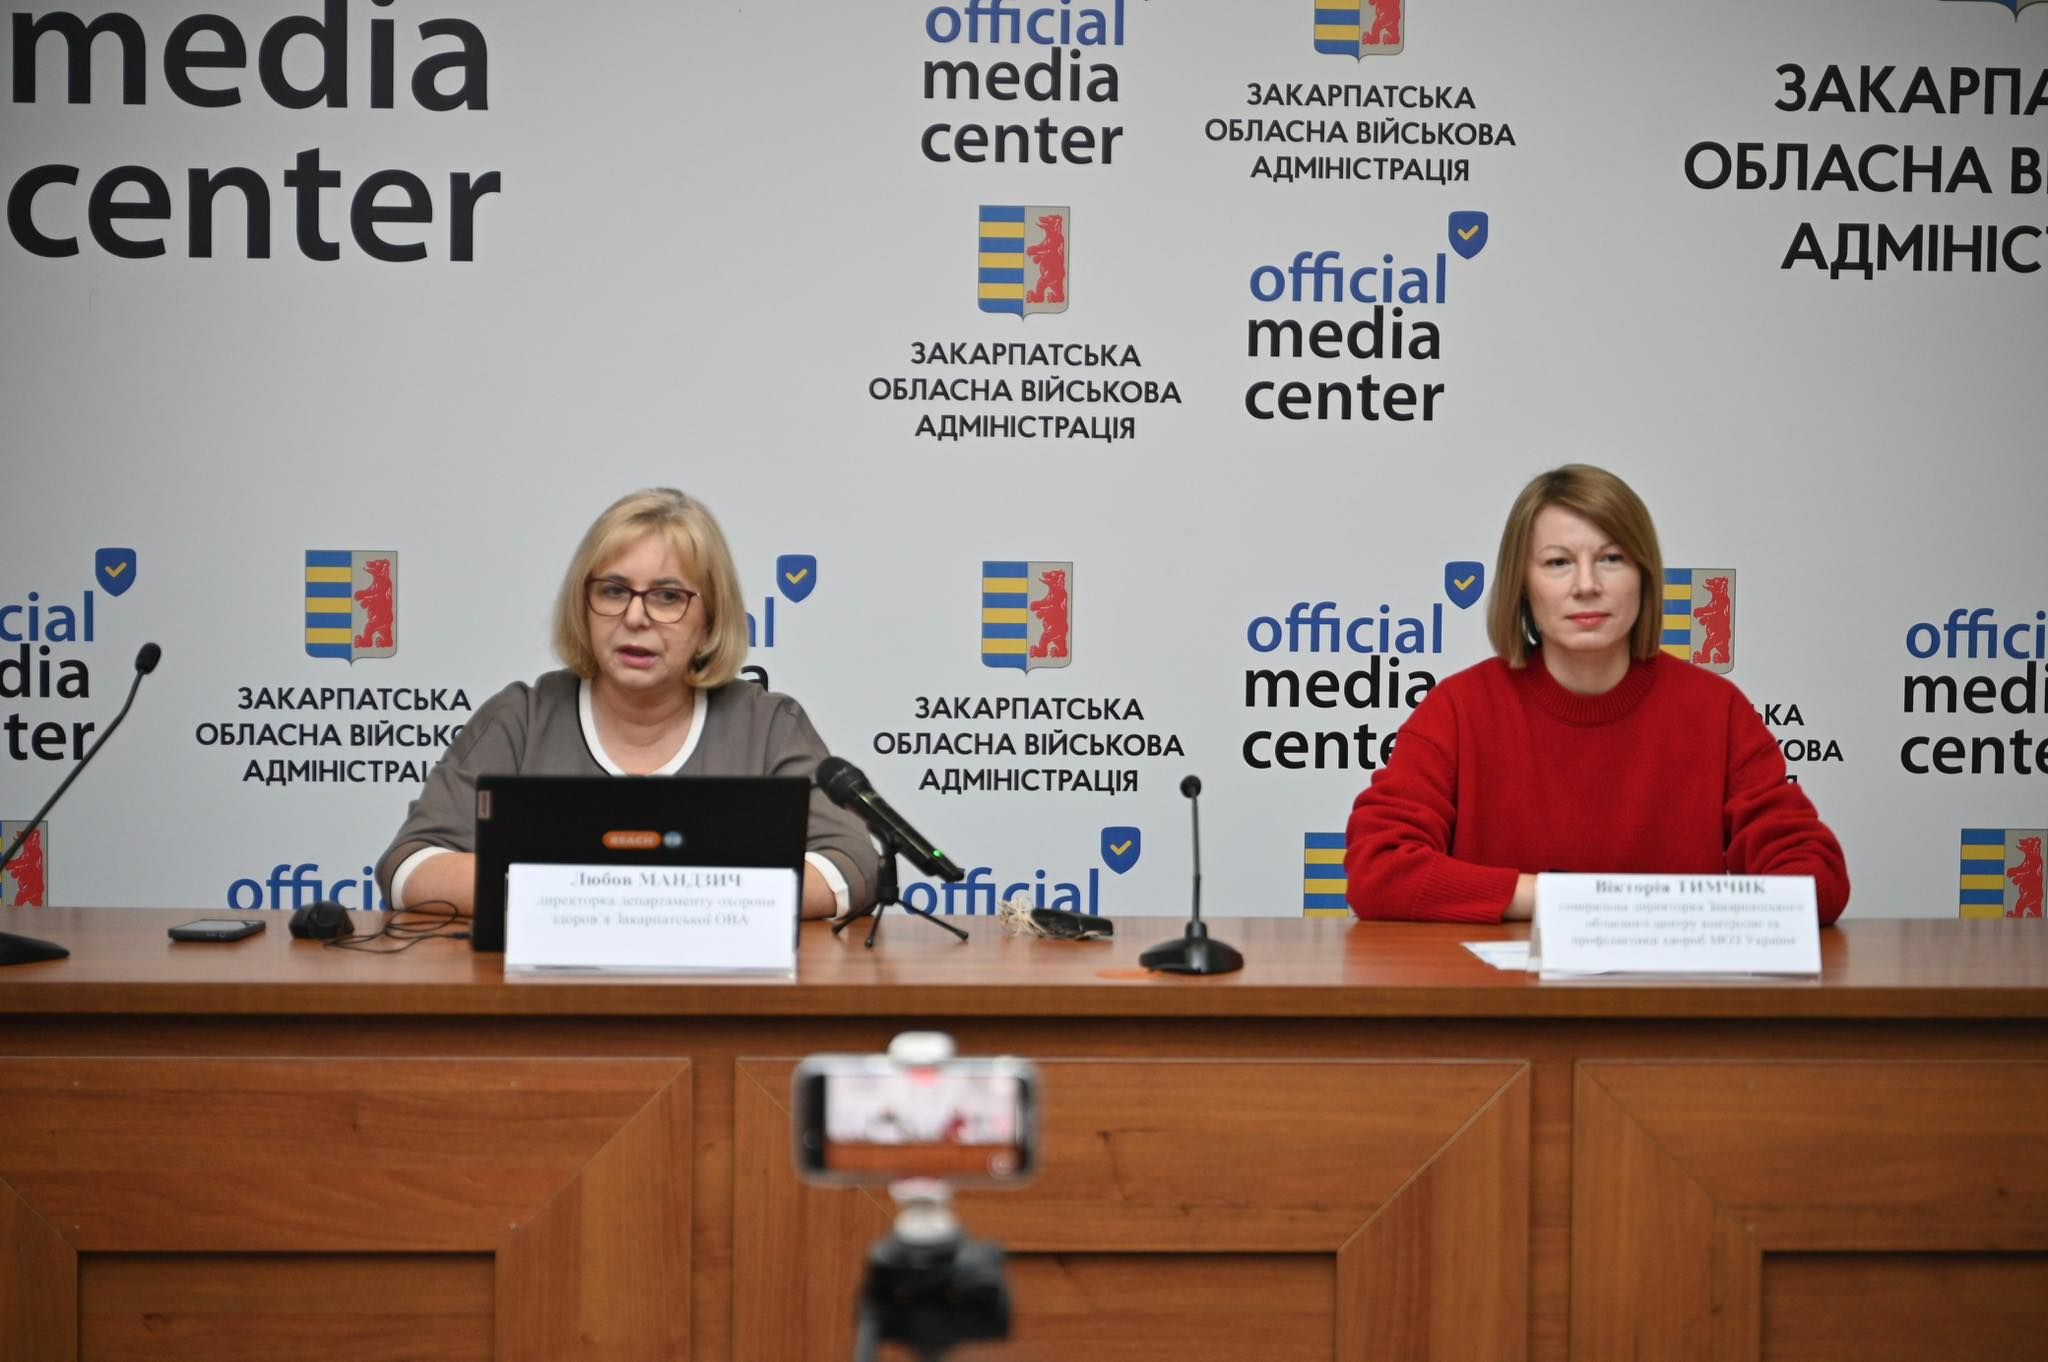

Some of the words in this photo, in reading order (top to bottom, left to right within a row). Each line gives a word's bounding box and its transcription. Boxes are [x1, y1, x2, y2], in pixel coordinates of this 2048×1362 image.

[926, 0, 1124, 45] official
[12, 0, 488, 111] media
[925, 47, 1118, 102] media
[1247, 83, 1475, 109] ЗАКАРПАТСЬКА
[922, 117, 1123, 164] center
[1205, 119, 1348, 143] ОБЛАСНА
[1357, 118, 1516, 145] ВІЙСЬКОВА
[1251, 156, 1468, 185] АДМІНІСТРАЦІЯ
[1685, 142, 1992, 193] ОБЛАСНА
[2011, 147, 2048, 194] В
[7, 148, 500, 262] center
[1781, 223, 2048, 280] АДМІНІС
[1250, 251, 1446, 303] official
[911, 342, 1141, 366] ЗАКАРПАТСЬКА
[1249, 305, 1439, 359] media
[869, 378, 1013, 401] ОБЛАСНА
[1022, 376, 1181, 403] ВІЙСЬКОВА
[1246, 375, 1444, 421] center
[915, 415, 1134, 443] АДМІНІСТРАЦІЯ
[1247, 601, 1442, 654] official
[238, 687, 471, 710] ЗАКАРПАТСЬКА
[1246, 655, 1437, 708] media
[915, 697, 1144, 720] ЗАКАРПАТСЬКА
[196, 723, 341, 746] ОБЛАСНА
[874, 732, 1016, 755] ОБЛАСНА
[1025, 729, 1184, 756] ВІЙСЬКОВА
[242, 760, 433, 786] АДМІНІСТРА
[919, 769, 1137, 795] АДМІНІСТРАЦІЯ
[227, 863, 388, 912] offici
